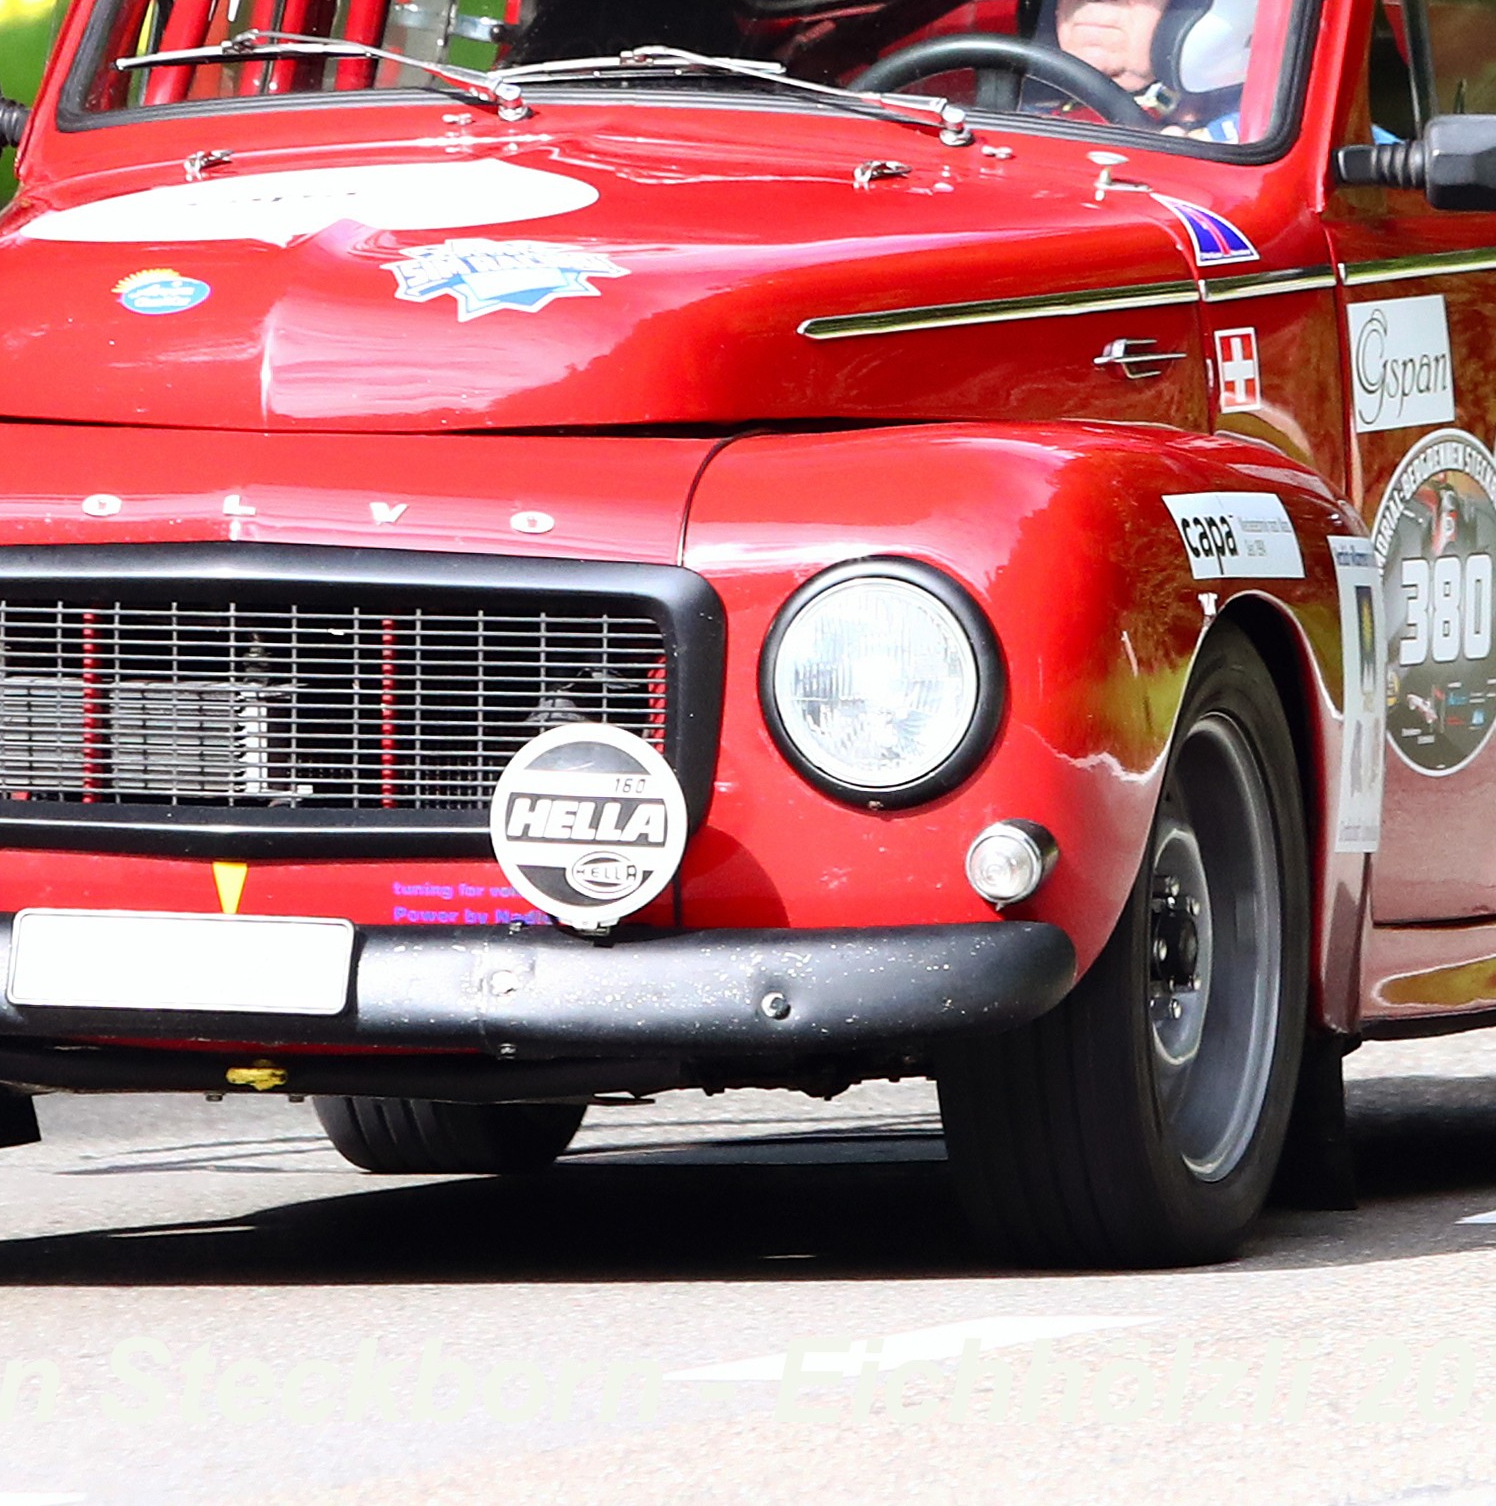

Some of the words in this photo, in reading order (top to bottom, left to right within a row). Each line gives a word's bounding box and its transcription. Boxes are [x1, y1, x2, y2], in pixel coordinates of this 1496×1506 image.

[1355, 308, 1447, 426] Gspan
[1180, 514, 1239, 576] capa
[1399, 551, 1494, 666] 380
[614, 777, 646, 794] 160
[507, 797, 665, 843] HELLA
[576, 864, 637, 882] HELLA
[393, 882, 453, 899] tuning
[458, 882, 484, 897] for
[393, 906, 459, 923] Power
[464, 908, 488, 924] by
